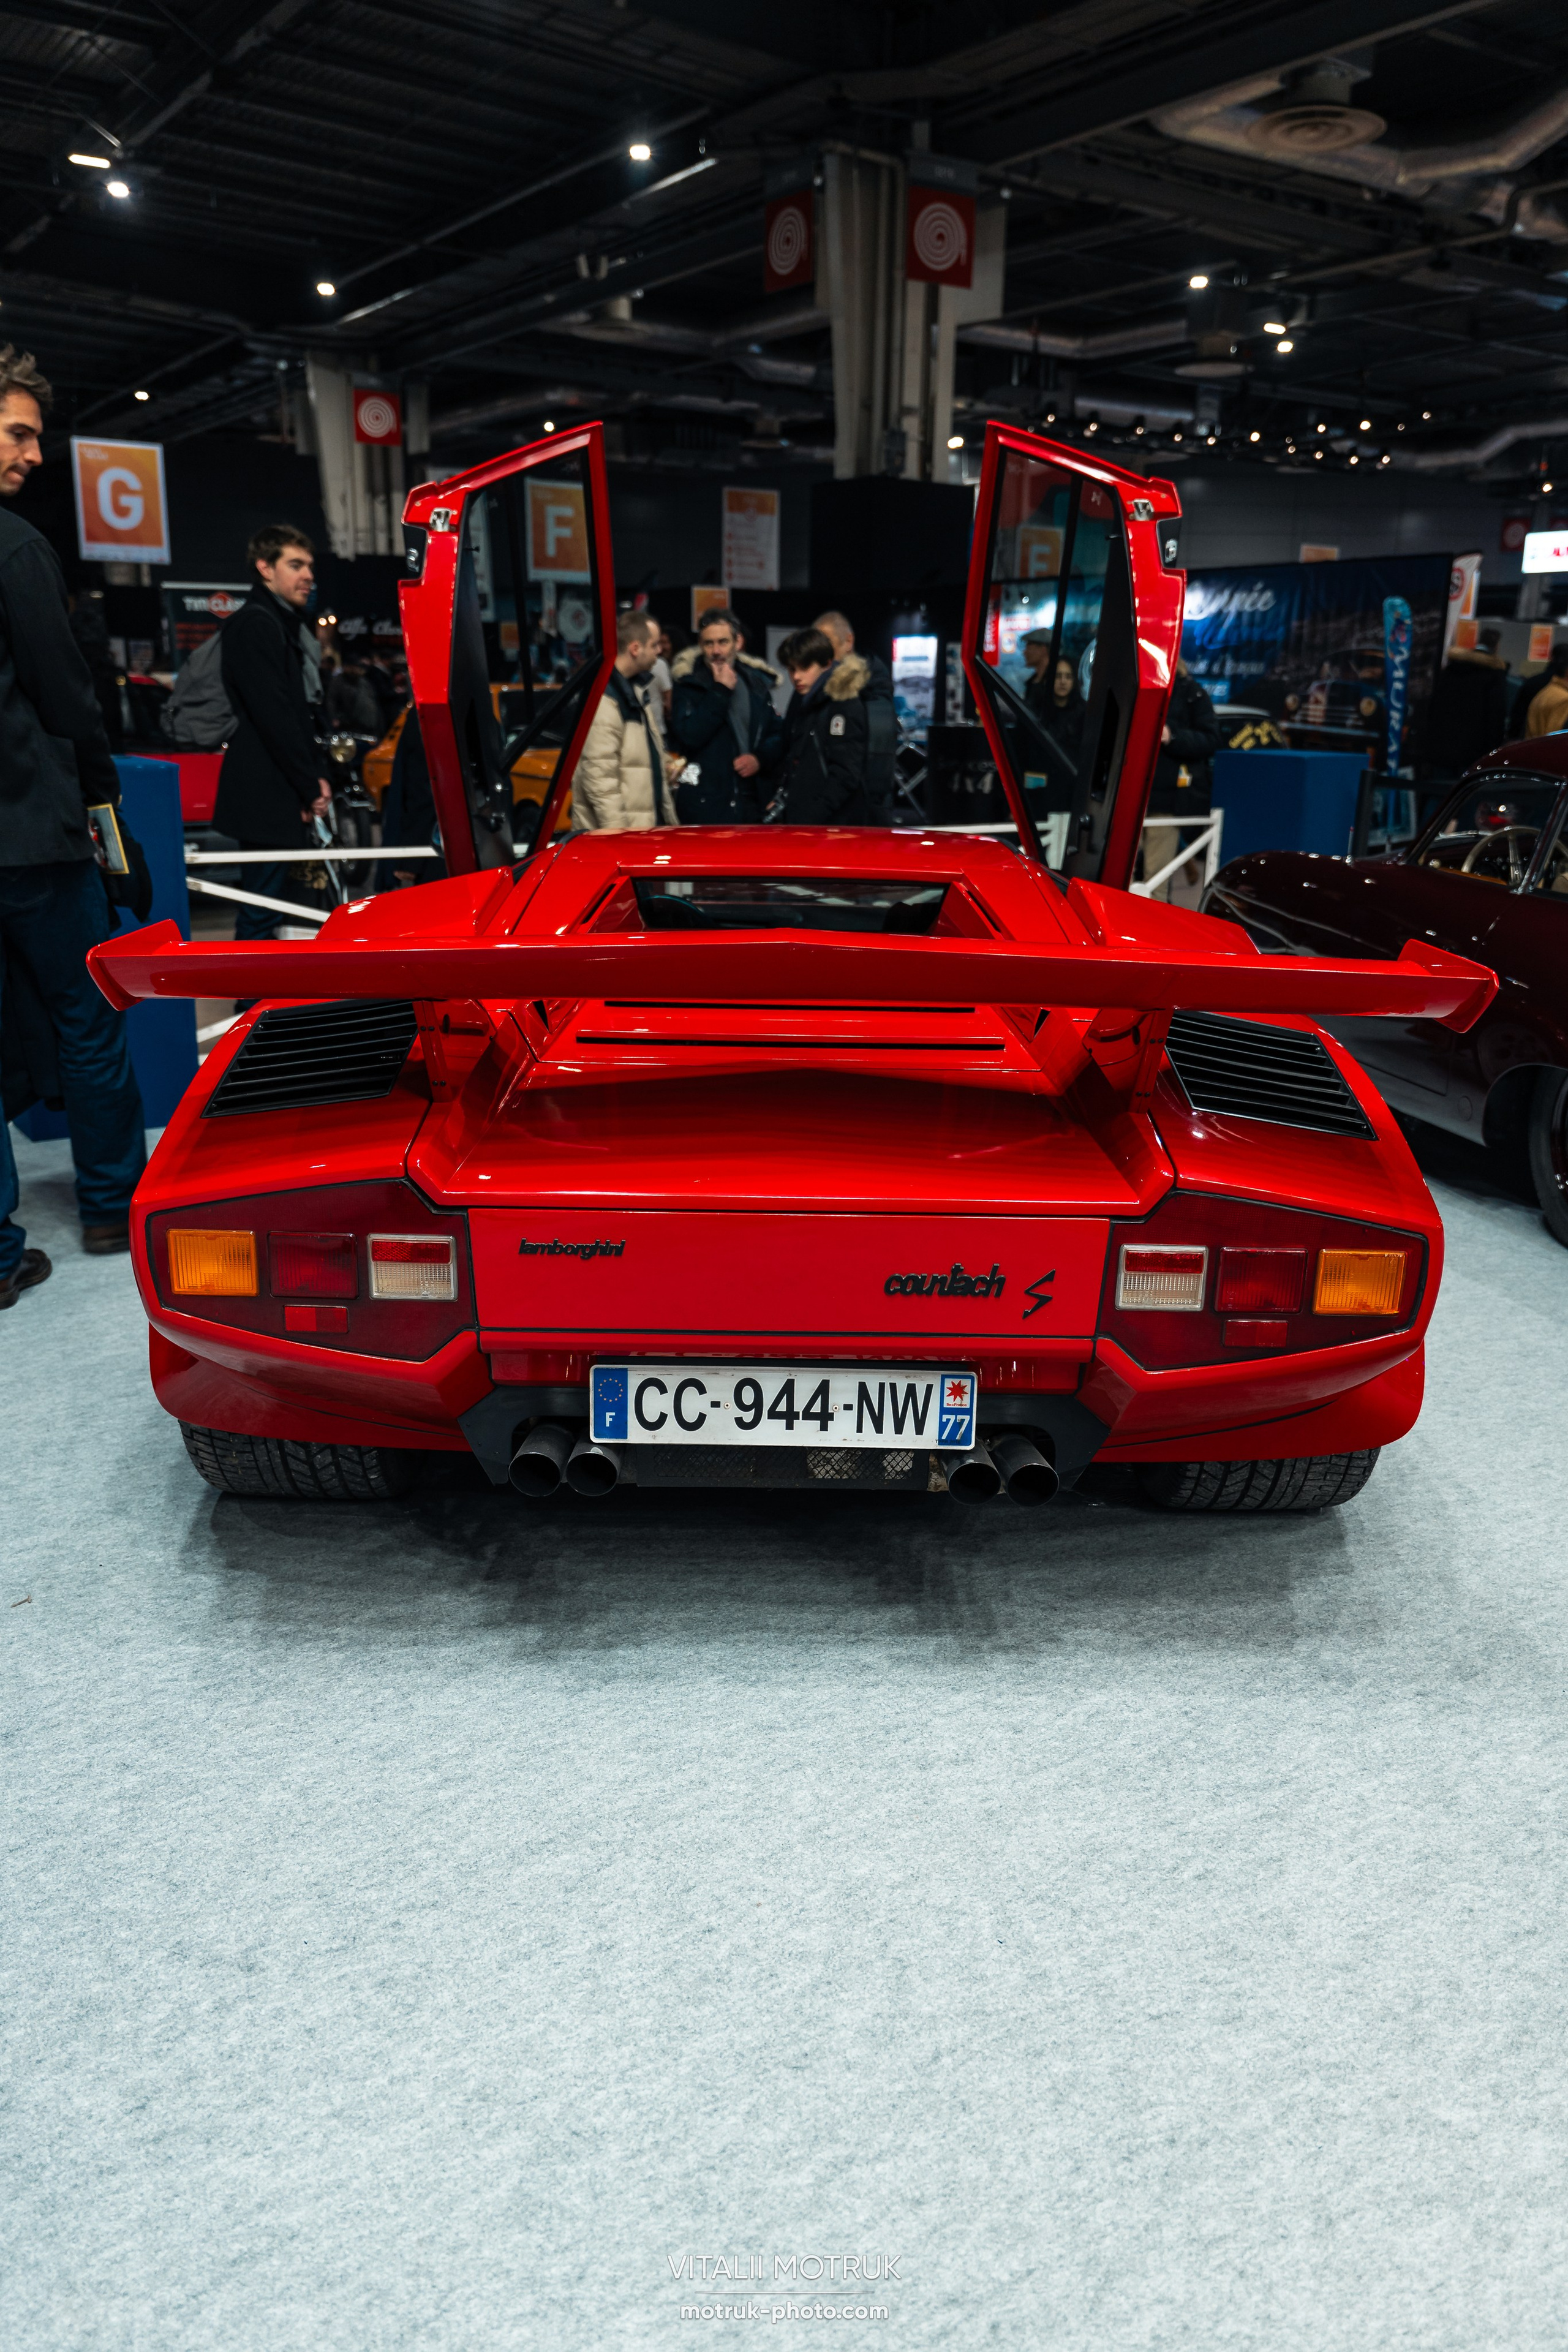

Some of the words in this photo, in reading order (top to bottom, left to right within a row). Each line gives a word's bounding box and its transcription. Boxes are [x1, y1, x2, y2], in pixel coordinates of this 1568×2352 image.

[97, 466, 145, 531] G
[544, 505, 575, 557] F
[519, 1238, 626, 1259] lamborghini
[884, 1263, 1006, 1297] countach
[605, 1412, 616, 1427] F
[634, 1378, 933, 1436] CC-944-NW
[941, 1414, 970, 1440] 77
